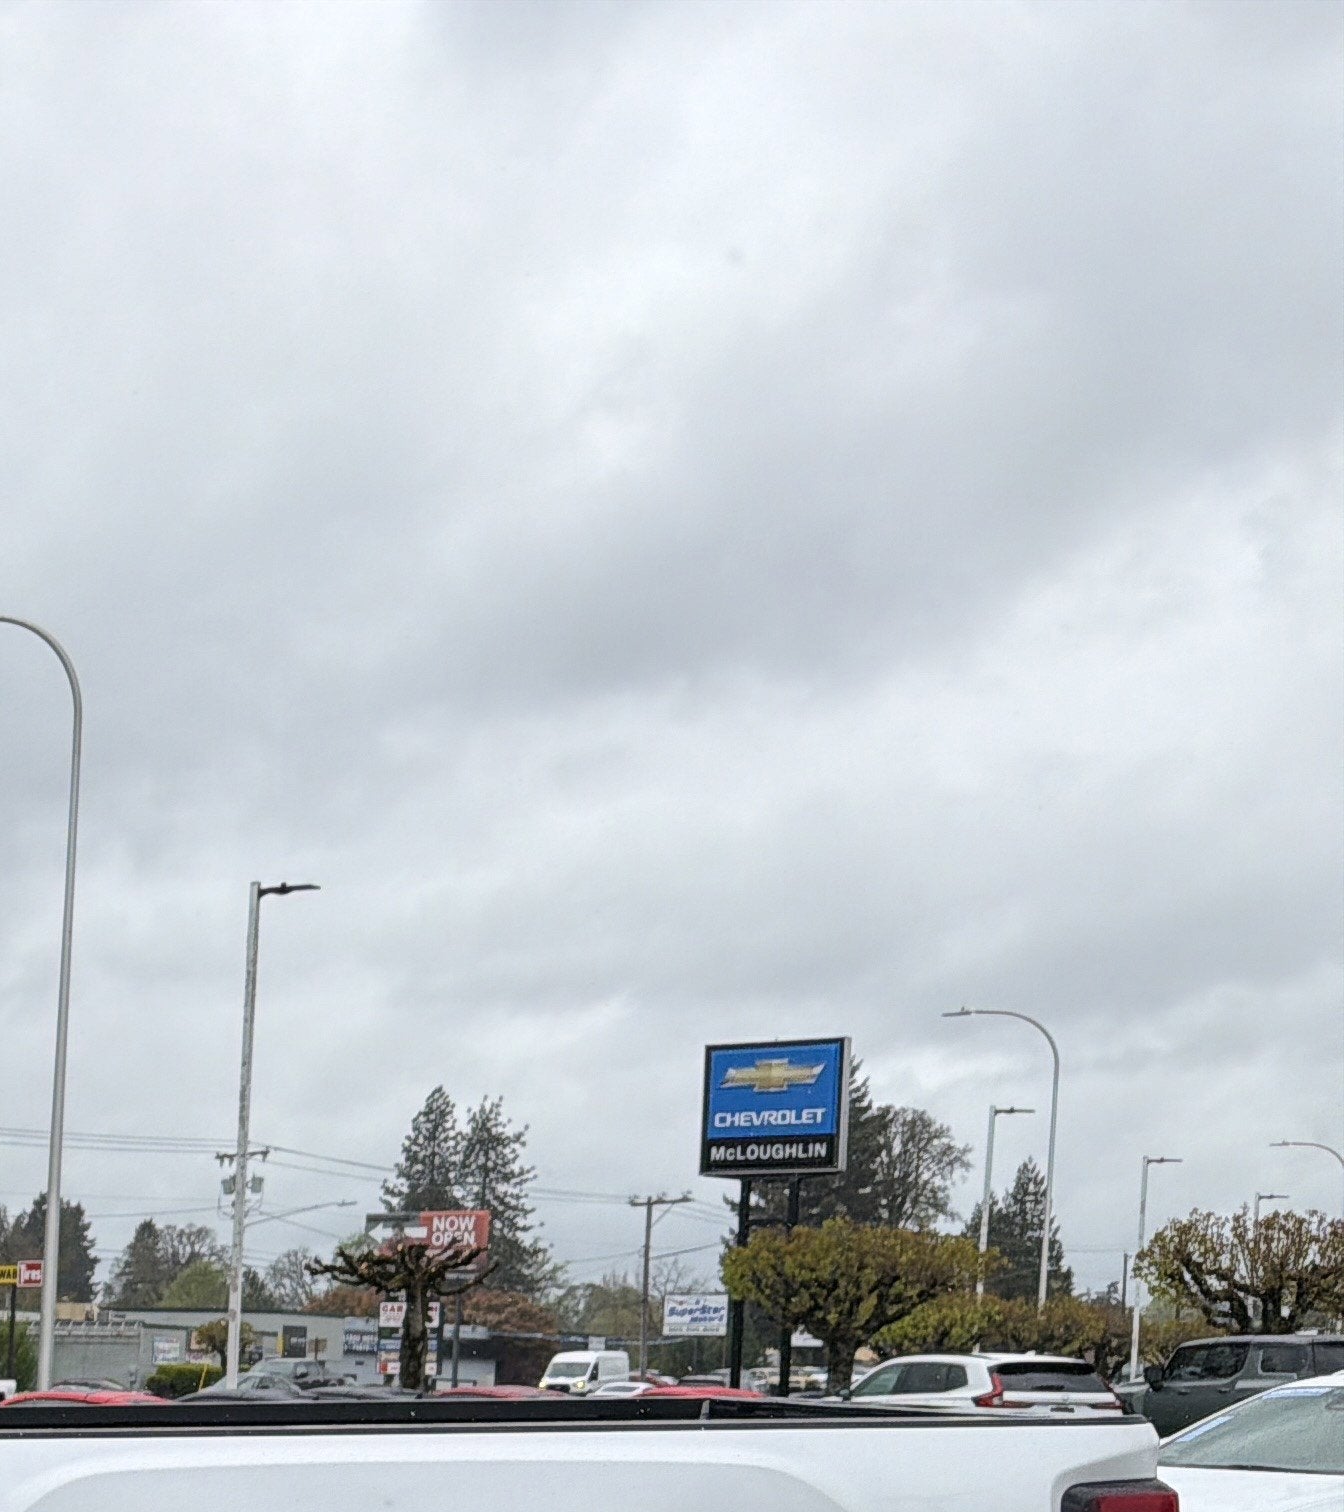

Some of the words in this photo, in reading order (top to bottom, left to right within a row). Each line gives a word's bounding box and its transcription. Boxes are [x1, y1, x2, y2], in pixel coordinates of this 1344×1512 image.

[714, 1108, 826, 1128] CHEVROLET
[710, 1142, 827, 1161] McLOUGHLIN
[432, 1215, 475, 1231] NOW
